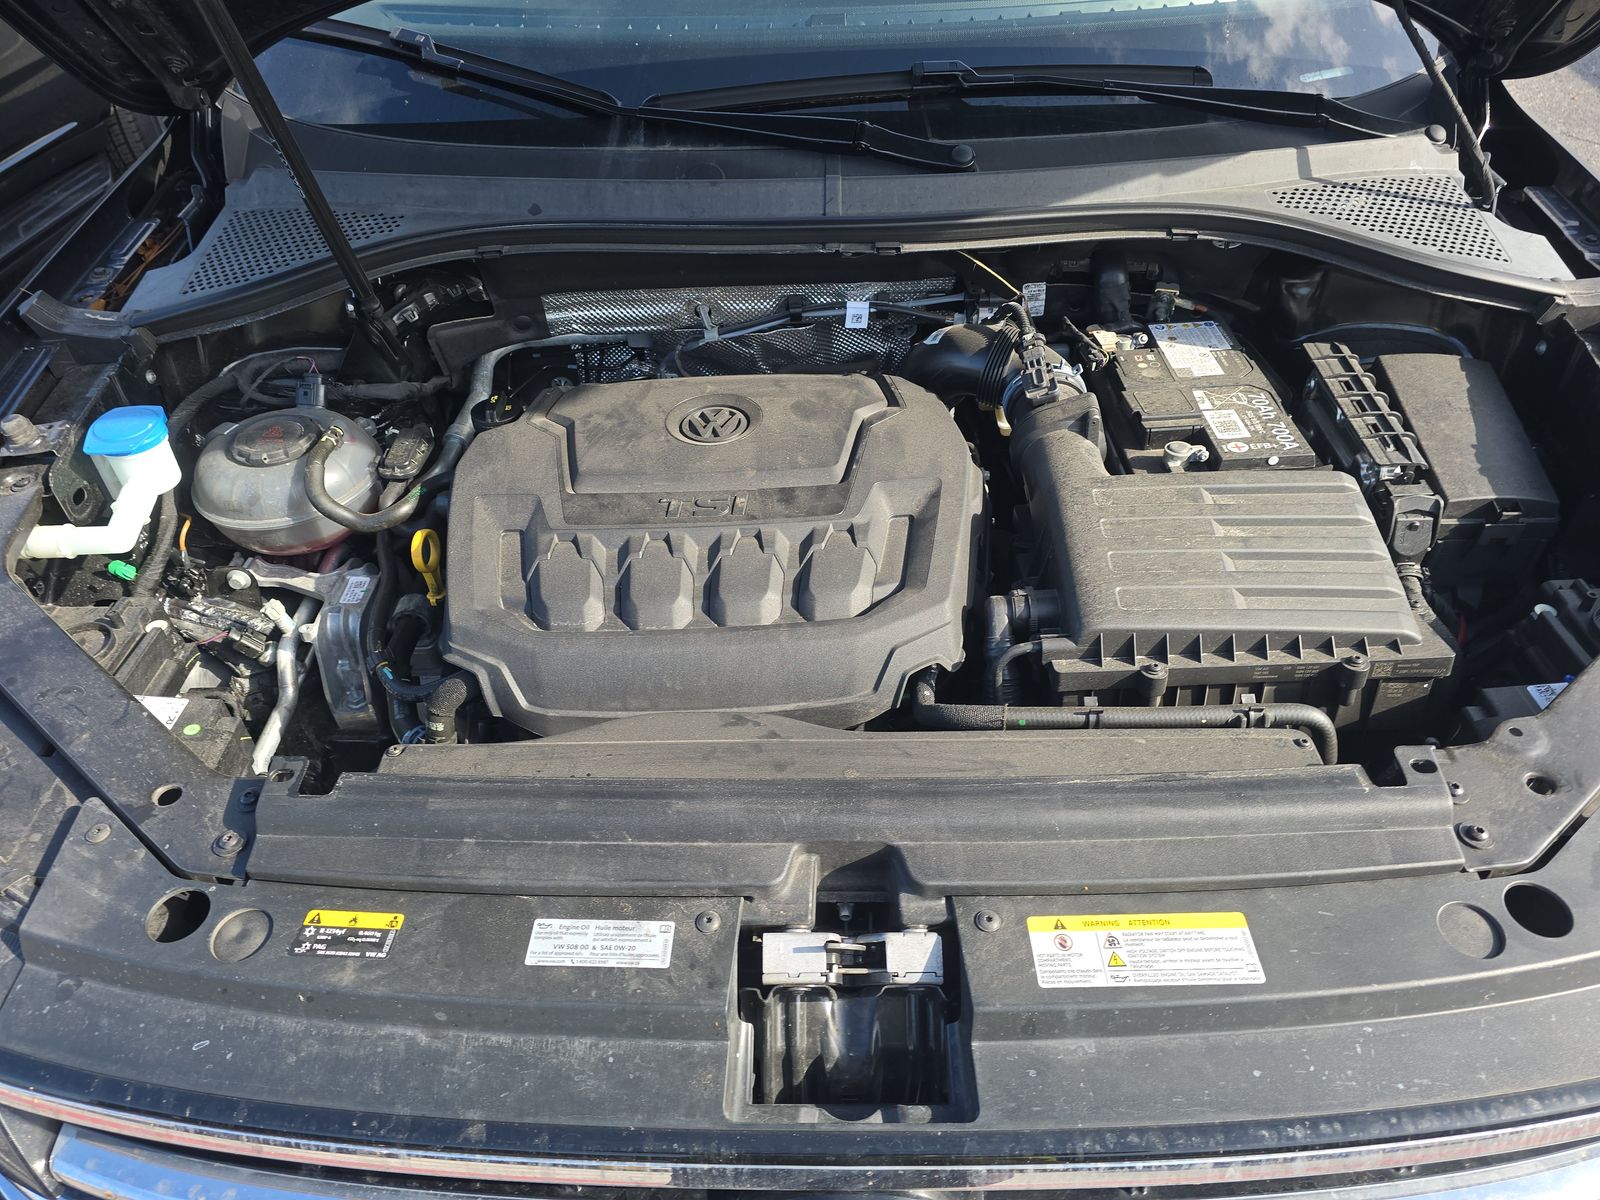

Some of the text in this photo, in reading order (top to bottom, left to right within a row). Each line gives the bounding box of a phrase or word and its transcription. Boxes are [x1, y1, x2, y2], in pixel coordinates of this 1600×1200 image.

[679, 405, 750, 443] VW
[1247, 392, 1277, 419] 70Ah
[1266, 421, 1299, 450] 700A
[1249, 442, 1279, 450] EFB+
[658, 493, 749, 519] TSI
[558, 923, 580, 931] Engine
